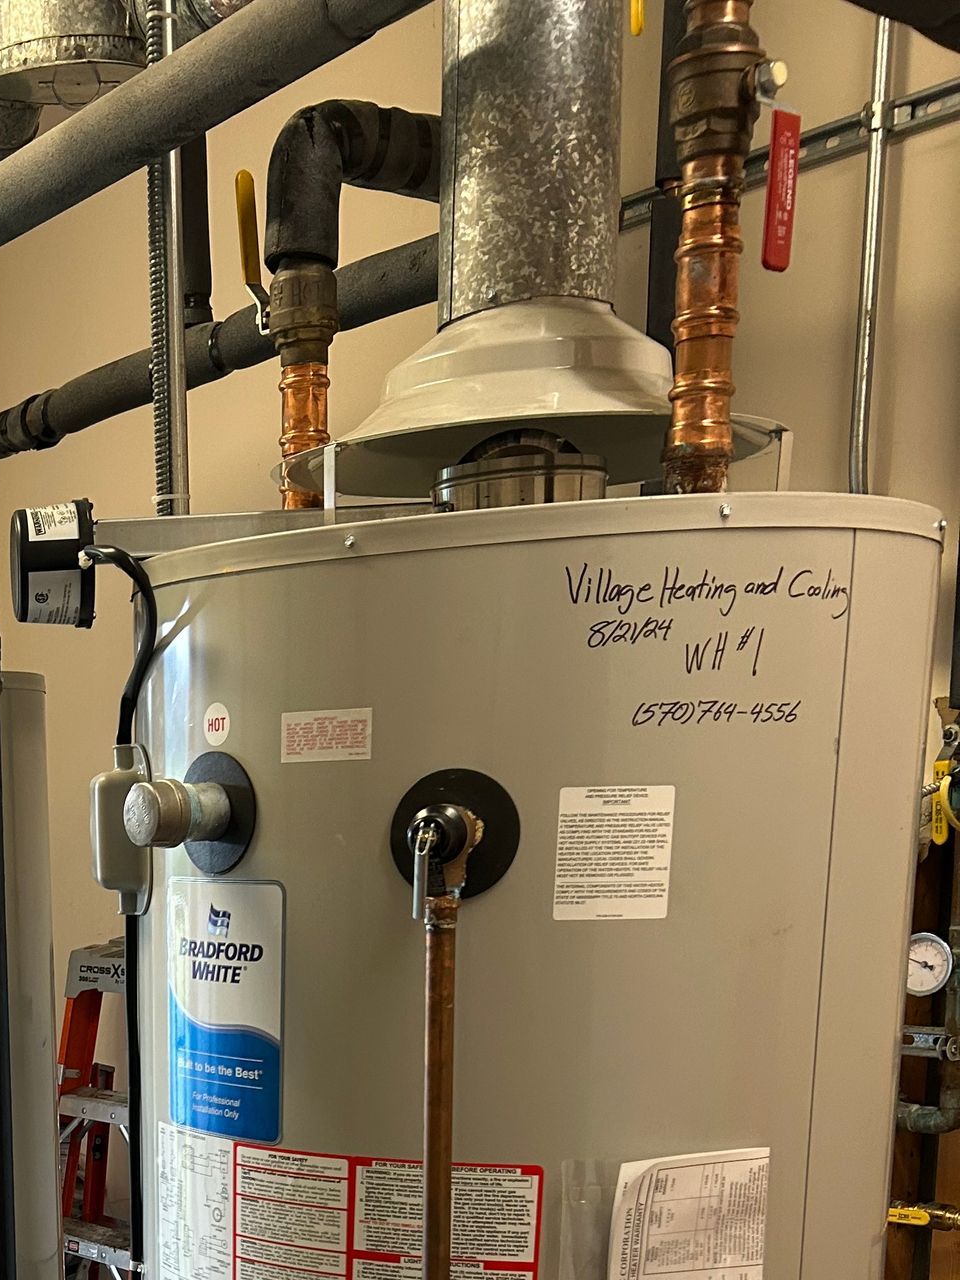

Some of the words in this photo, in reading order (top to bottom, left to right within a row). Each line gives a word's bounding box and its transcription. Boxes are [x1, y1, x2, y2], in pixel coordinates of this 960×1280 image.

[787, 149, 795, 210] LEGEND
[565, 563, 655, 615] Village
[660, 566, 737, 616] Heating
[744, 566, 784, 596] and
[788, 568, 850, 619] Cooling
[587, 617, 674, 648] 8/21/24
[685, 631, 728, 674] WH
[207, 717, 226, 733] HOT
[180, 937, 264, 962] BRADFORD
[192, 960, 243, 984] WHITE
[194, 1062, 203, 1072] to
[204, 1062, 216, 1075] be
[218, 1064, 232, 1077] the
[235, 1066, 259, 1080] Best
[202, 1092, 240, 1108] Professional
[224, 1108, 240, 1120] Only
[635, 1203, 645, 1245] WARRANTY
[620, 1208, 633, 1276] CORPORATION
[632, 1248, 641, 1277] HEATER
